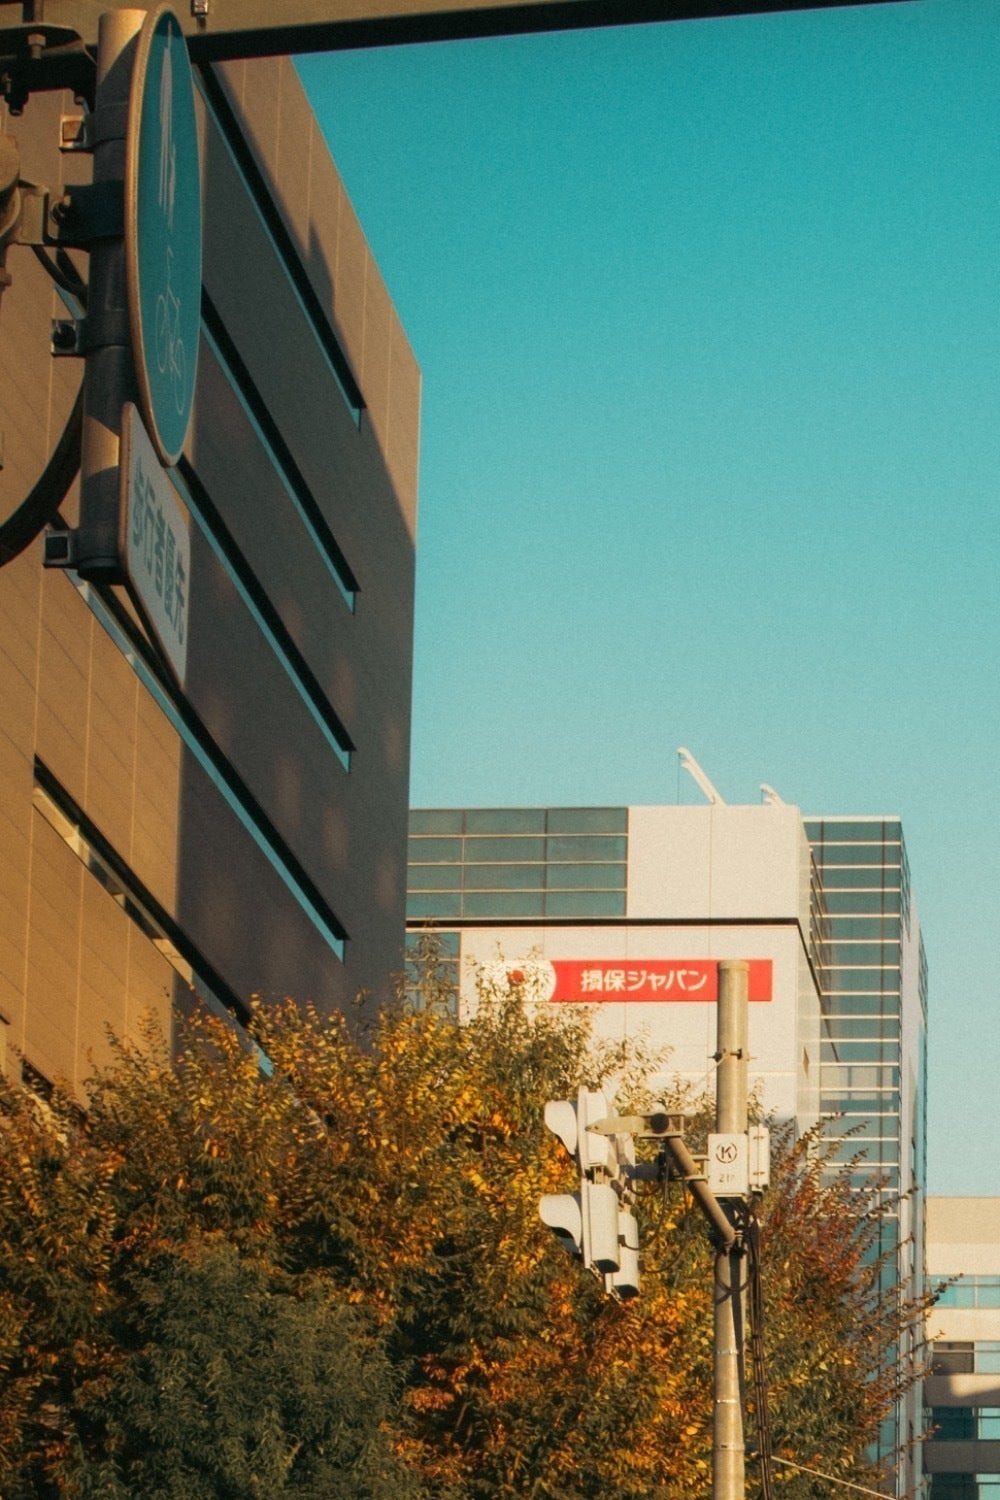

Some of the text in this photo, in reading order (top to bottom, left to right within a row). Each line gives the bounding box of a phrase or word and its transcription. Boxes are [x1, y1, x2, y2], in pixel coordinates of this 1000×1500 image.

[581, 969, 707, 992] 損保ジャパン
